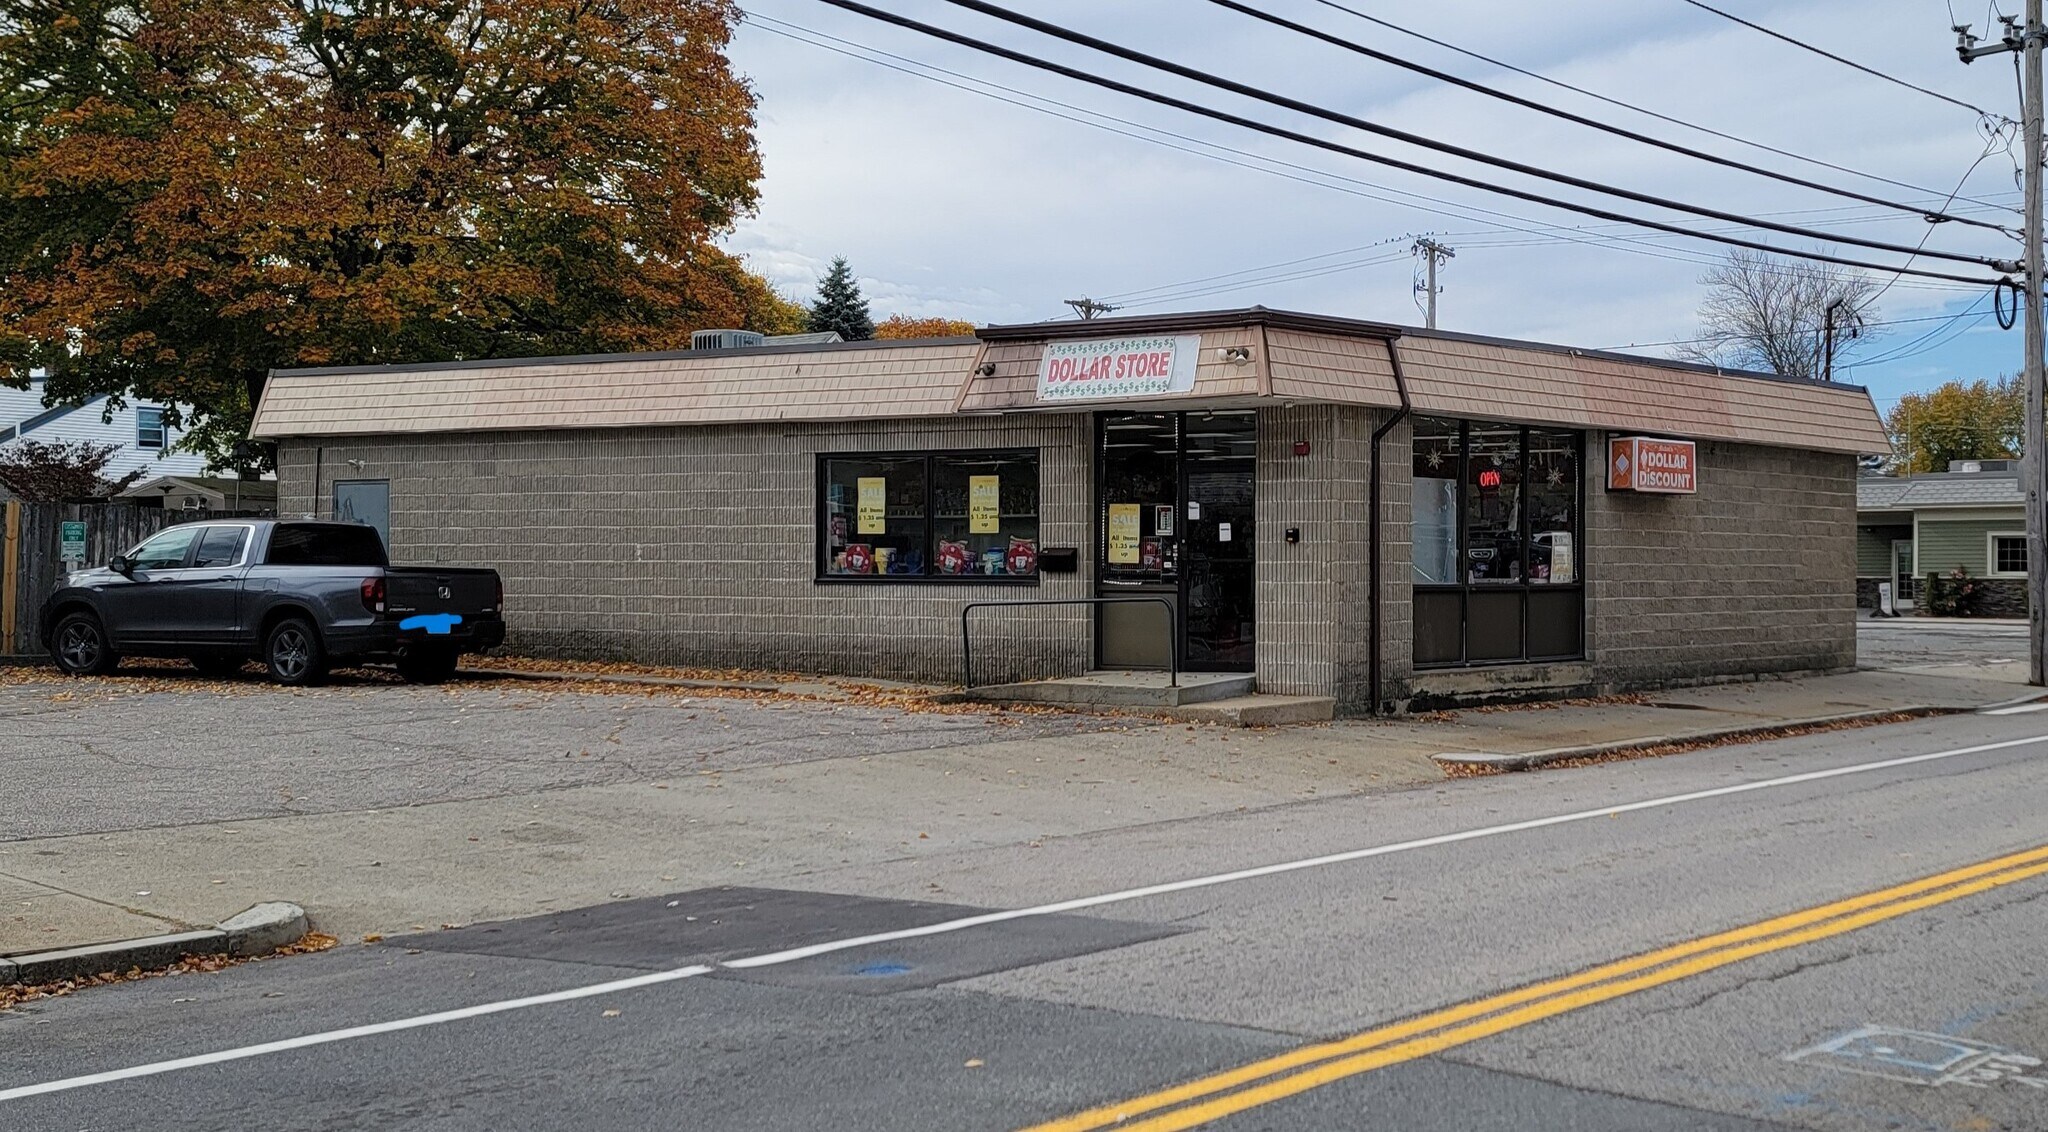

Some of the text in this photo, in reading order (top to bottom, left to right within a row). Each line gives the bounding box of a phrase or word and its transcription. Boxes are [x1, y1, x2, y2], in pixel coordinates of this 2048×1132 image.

[1047, 351, 1171, 383] DOLLAR STORE
[1648, 452, 1688, 470] DOLLAR
[1480, 471, 1500, 487] OPEN
[861, 488, 884, 497] SALE
[973, 486, 998, 497] SALE
[1112, 514, 1138, 525] SALE
